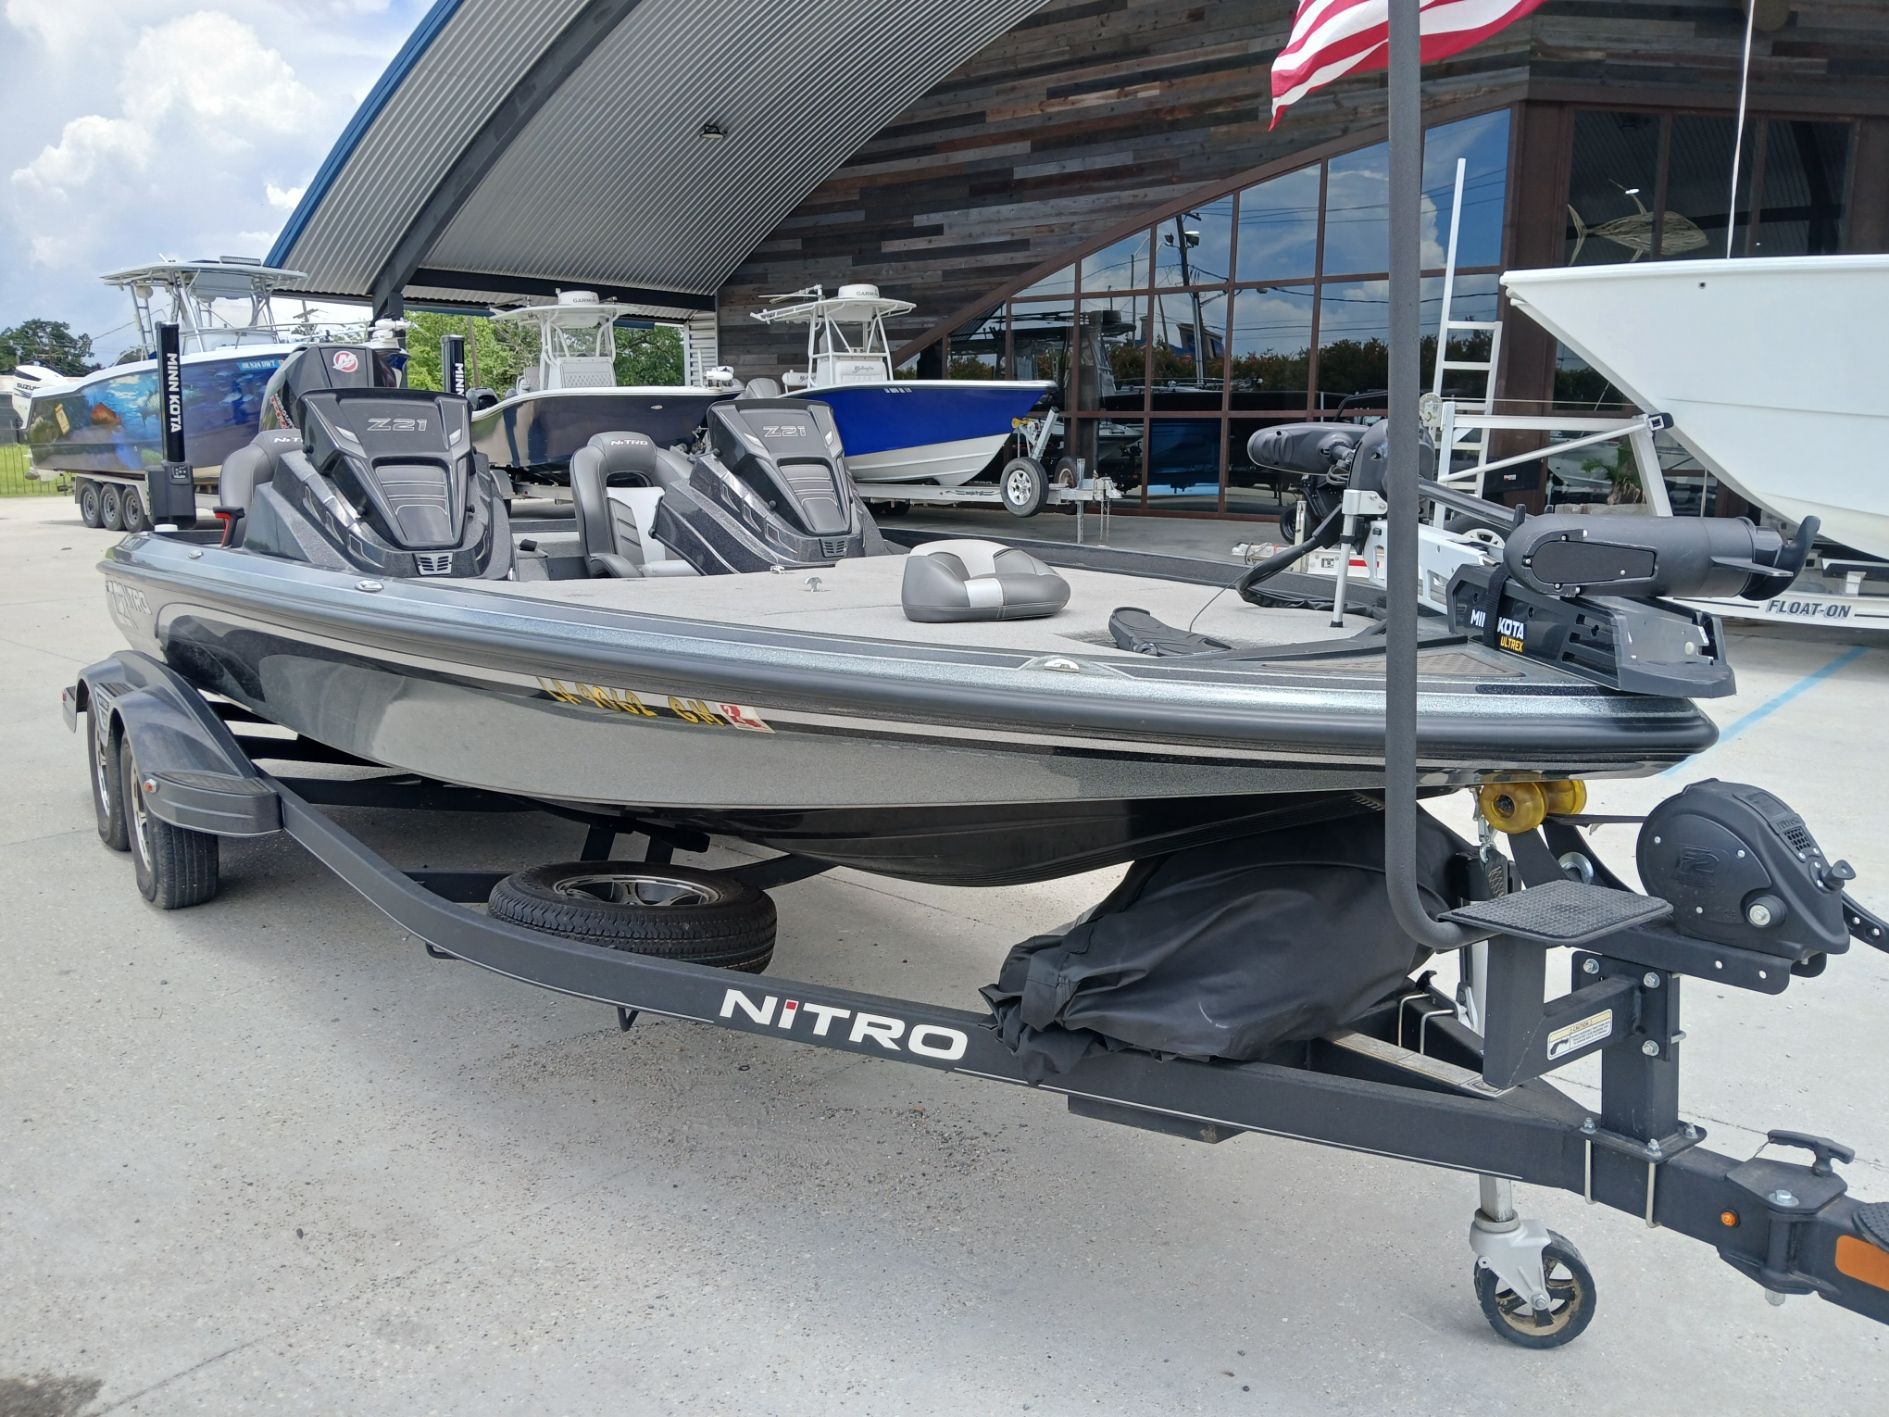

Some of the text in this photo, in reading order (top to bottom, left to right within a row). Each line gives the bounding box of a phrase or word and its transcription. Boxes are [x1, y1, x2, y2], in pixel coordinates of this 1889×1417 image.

[17, 383, 41, 391] SUZU
[167, 353, 182, 433] MINN KOTA
[367, 418, 428, 432] Z21
[763, 425, 807, 438] Z21
[1766, 600, 1851, 618] FLOAT-ON
[1470, 609, 1524, 640] MI KOTA
[1500, 636, 1524, 653] ULTREX
